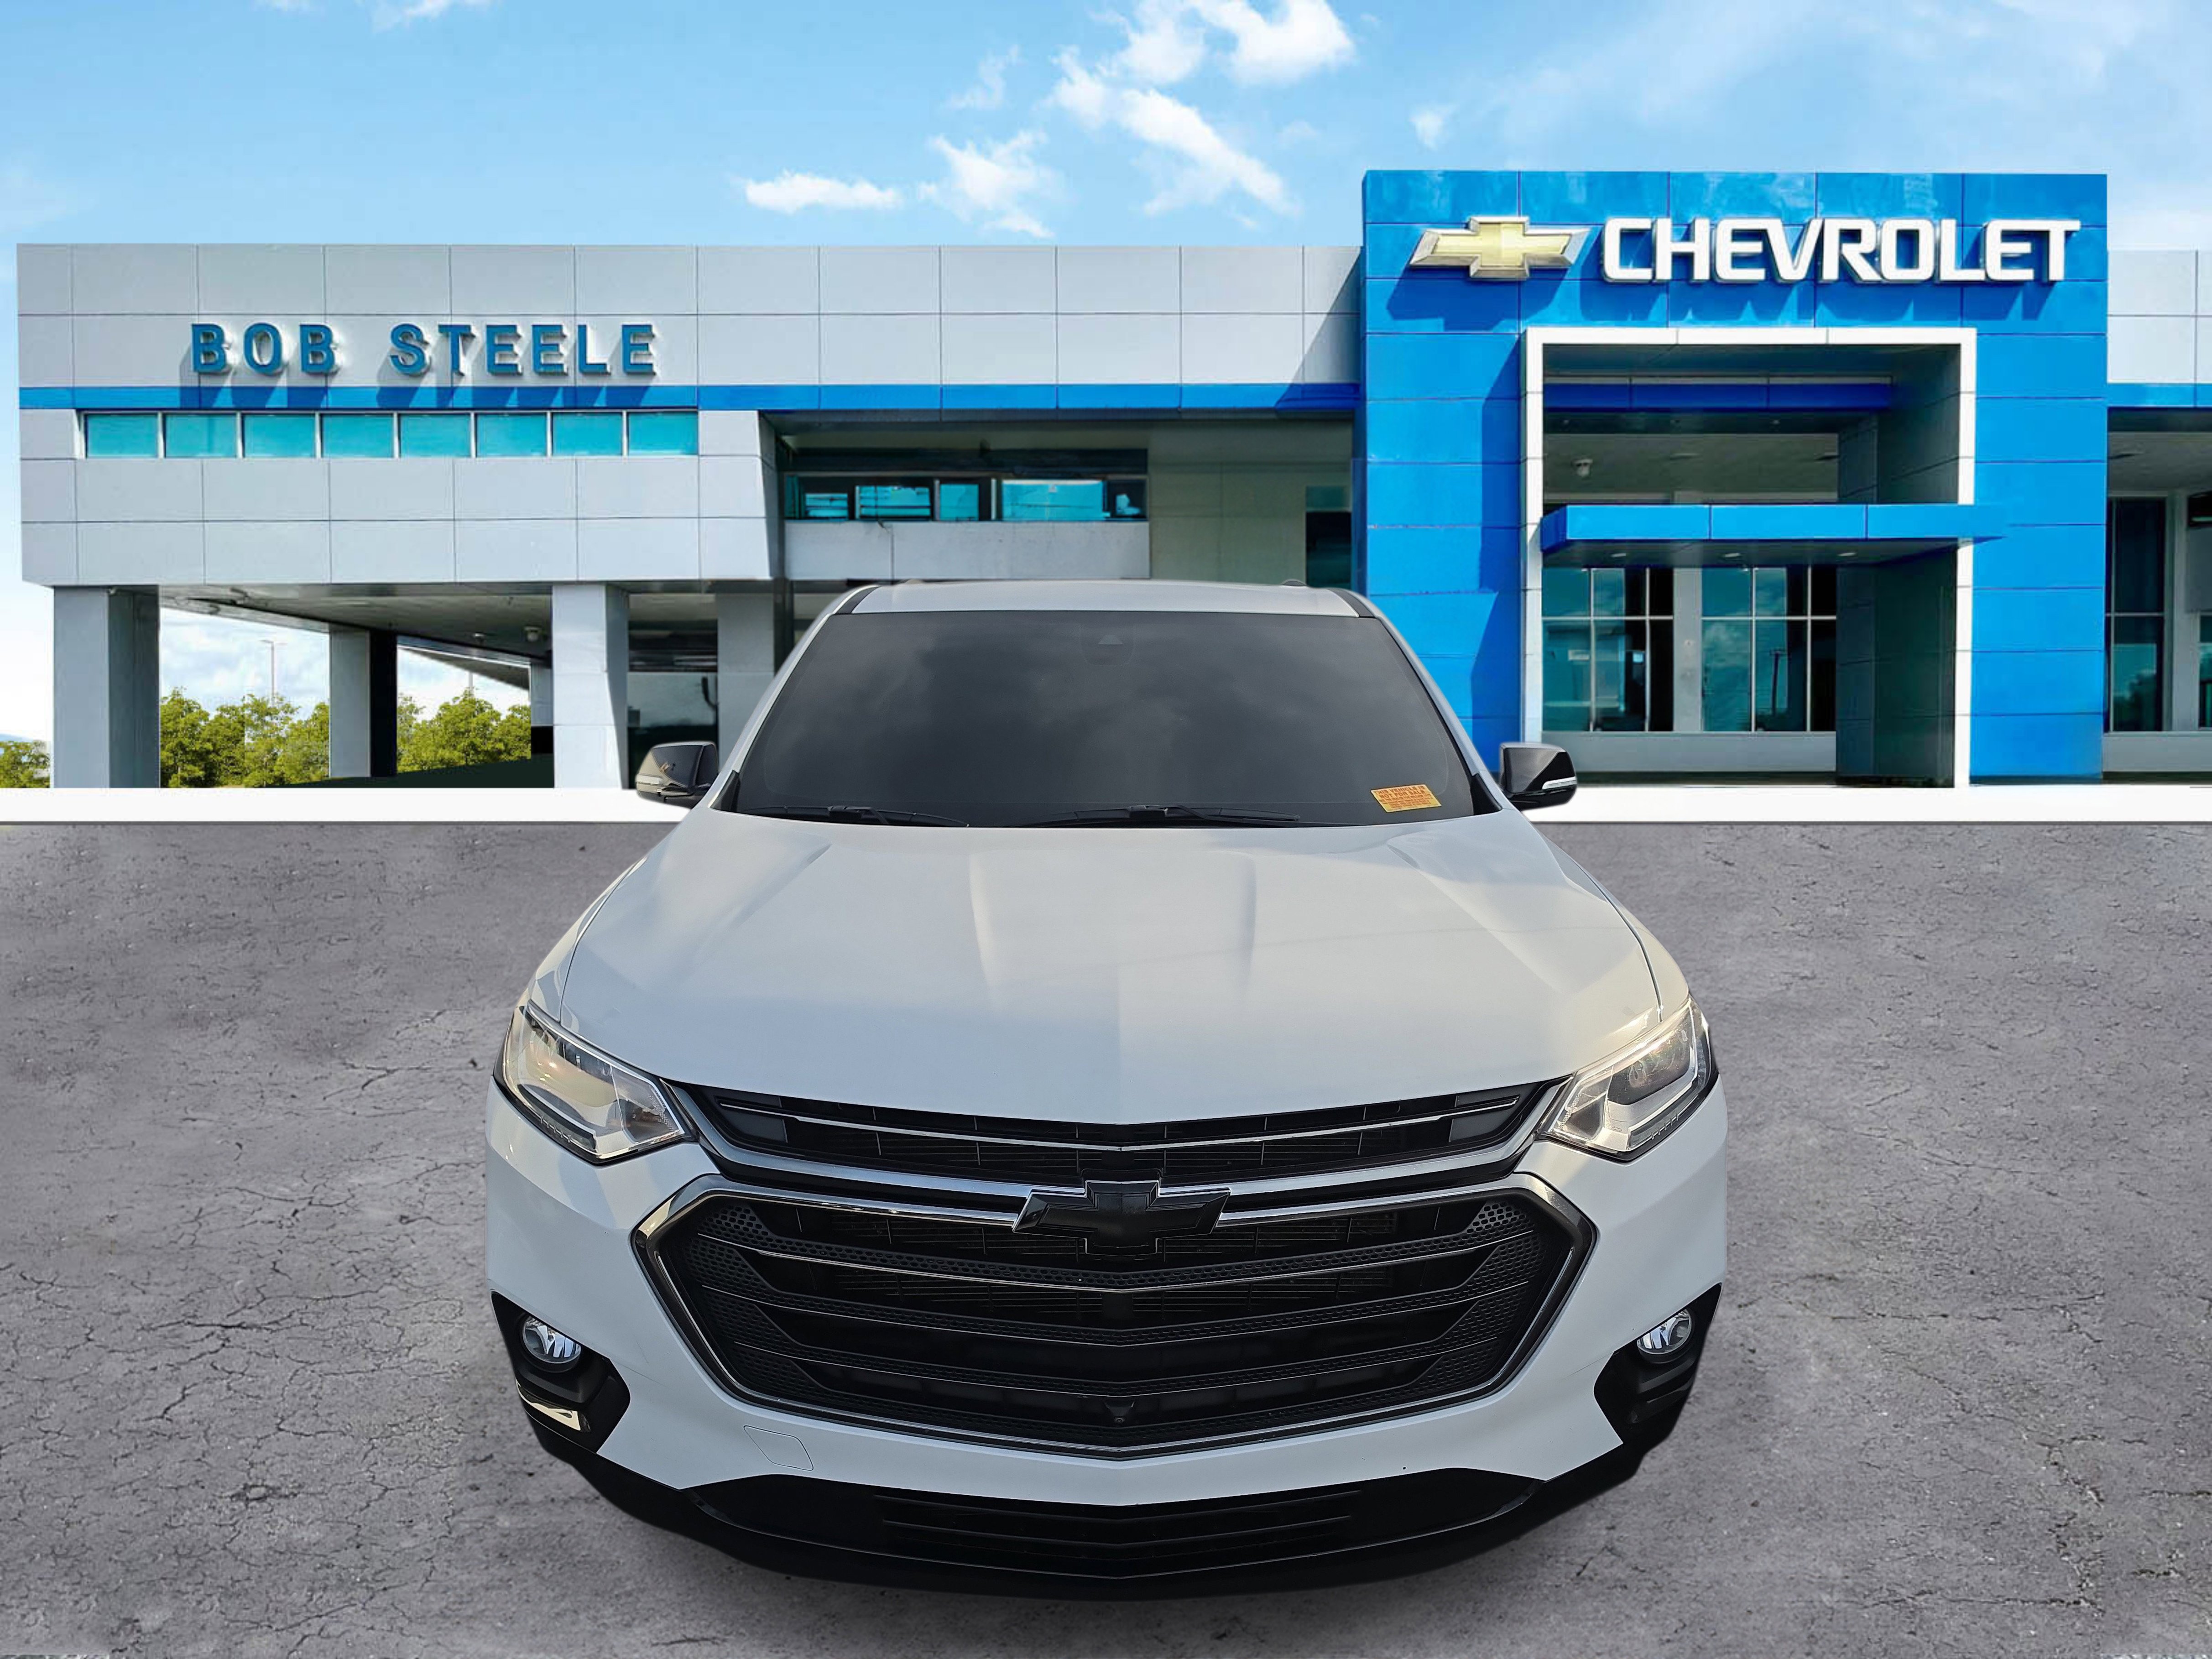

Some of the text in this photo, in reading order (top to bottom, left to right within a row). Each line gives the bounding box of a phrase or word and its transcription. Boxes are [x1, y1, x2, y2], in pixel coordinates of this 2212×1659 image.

[1604, 218, 2081, 282] CHEVROLET
[192, 323, 653, 375] BOB STEELE
